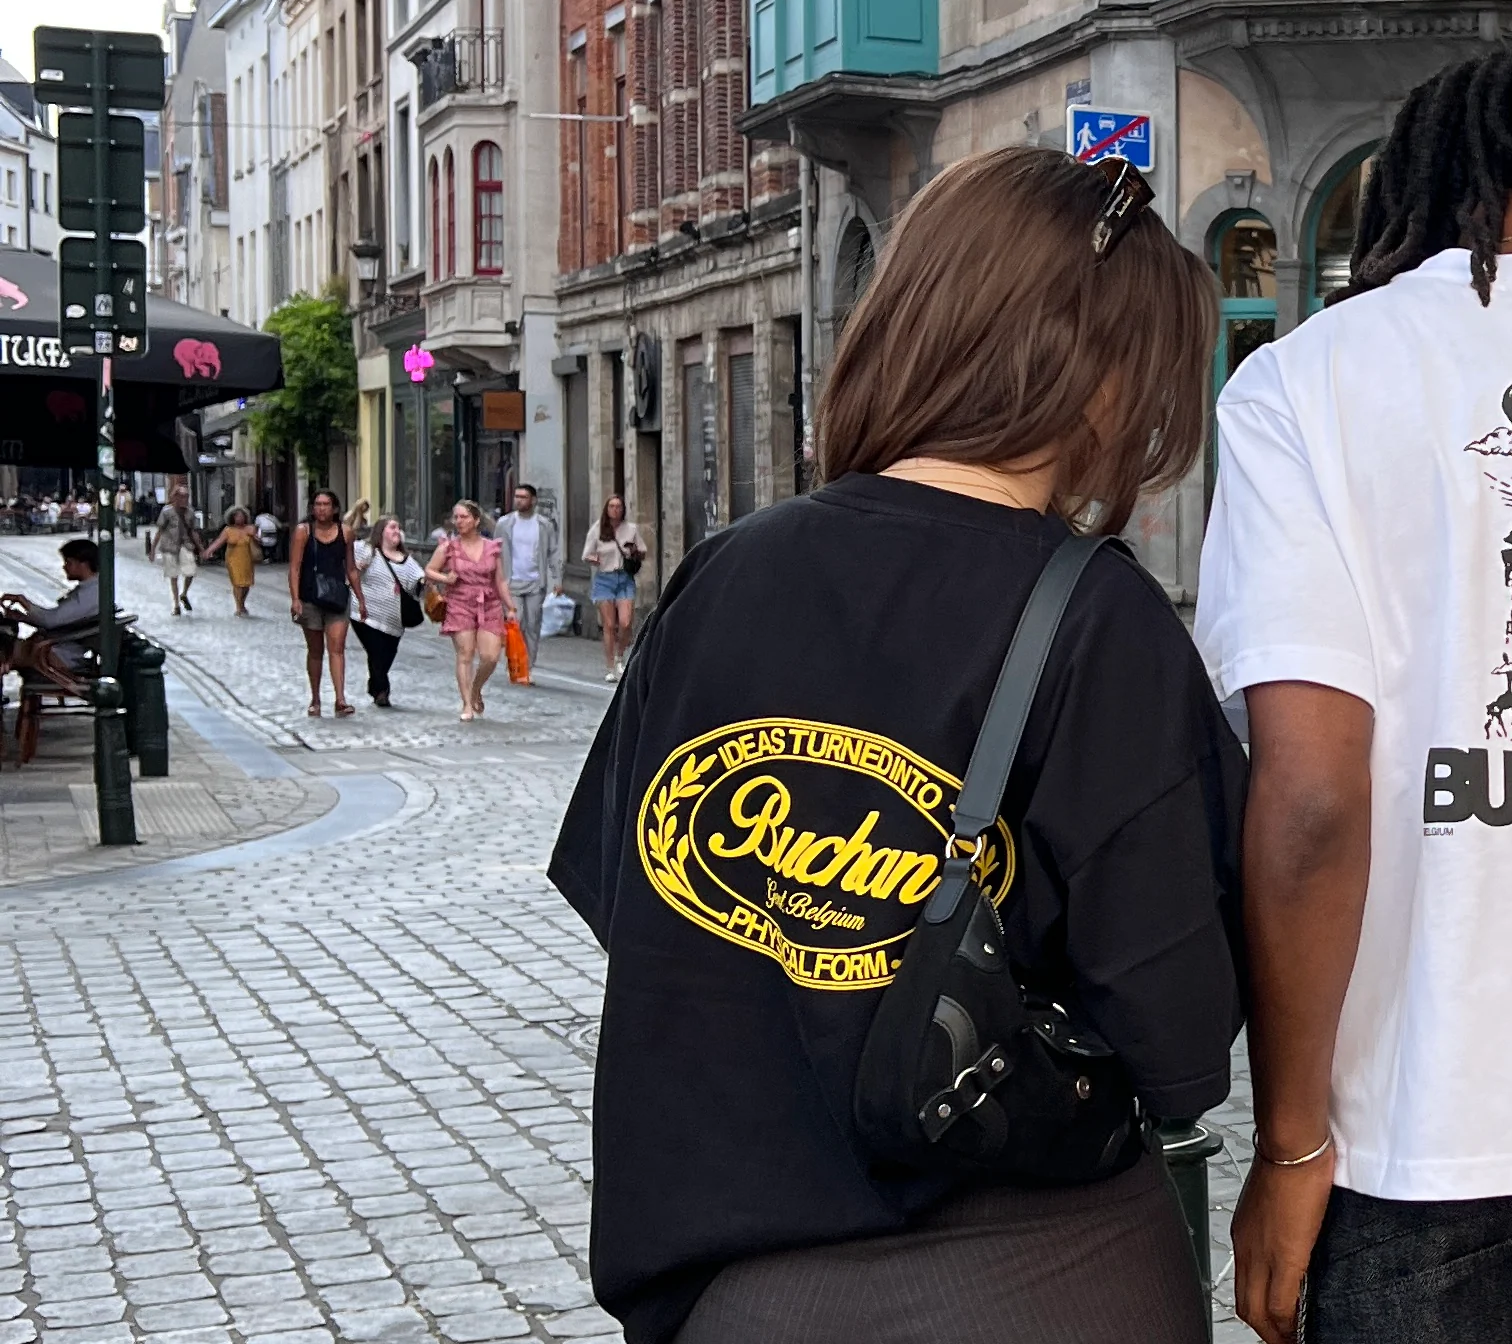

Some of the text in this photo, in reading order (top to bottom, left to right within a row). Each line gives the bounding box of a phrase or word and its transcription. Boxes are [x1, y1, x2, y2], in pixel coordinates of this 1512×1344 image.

[718, 728, 943, 810] IDEAS TURNED INTO
[708, 775, 942, 905] Buchan
[726, 905, 889, 981] PHYSCAL FORM
[786, 892, 865, 931] Belgium
